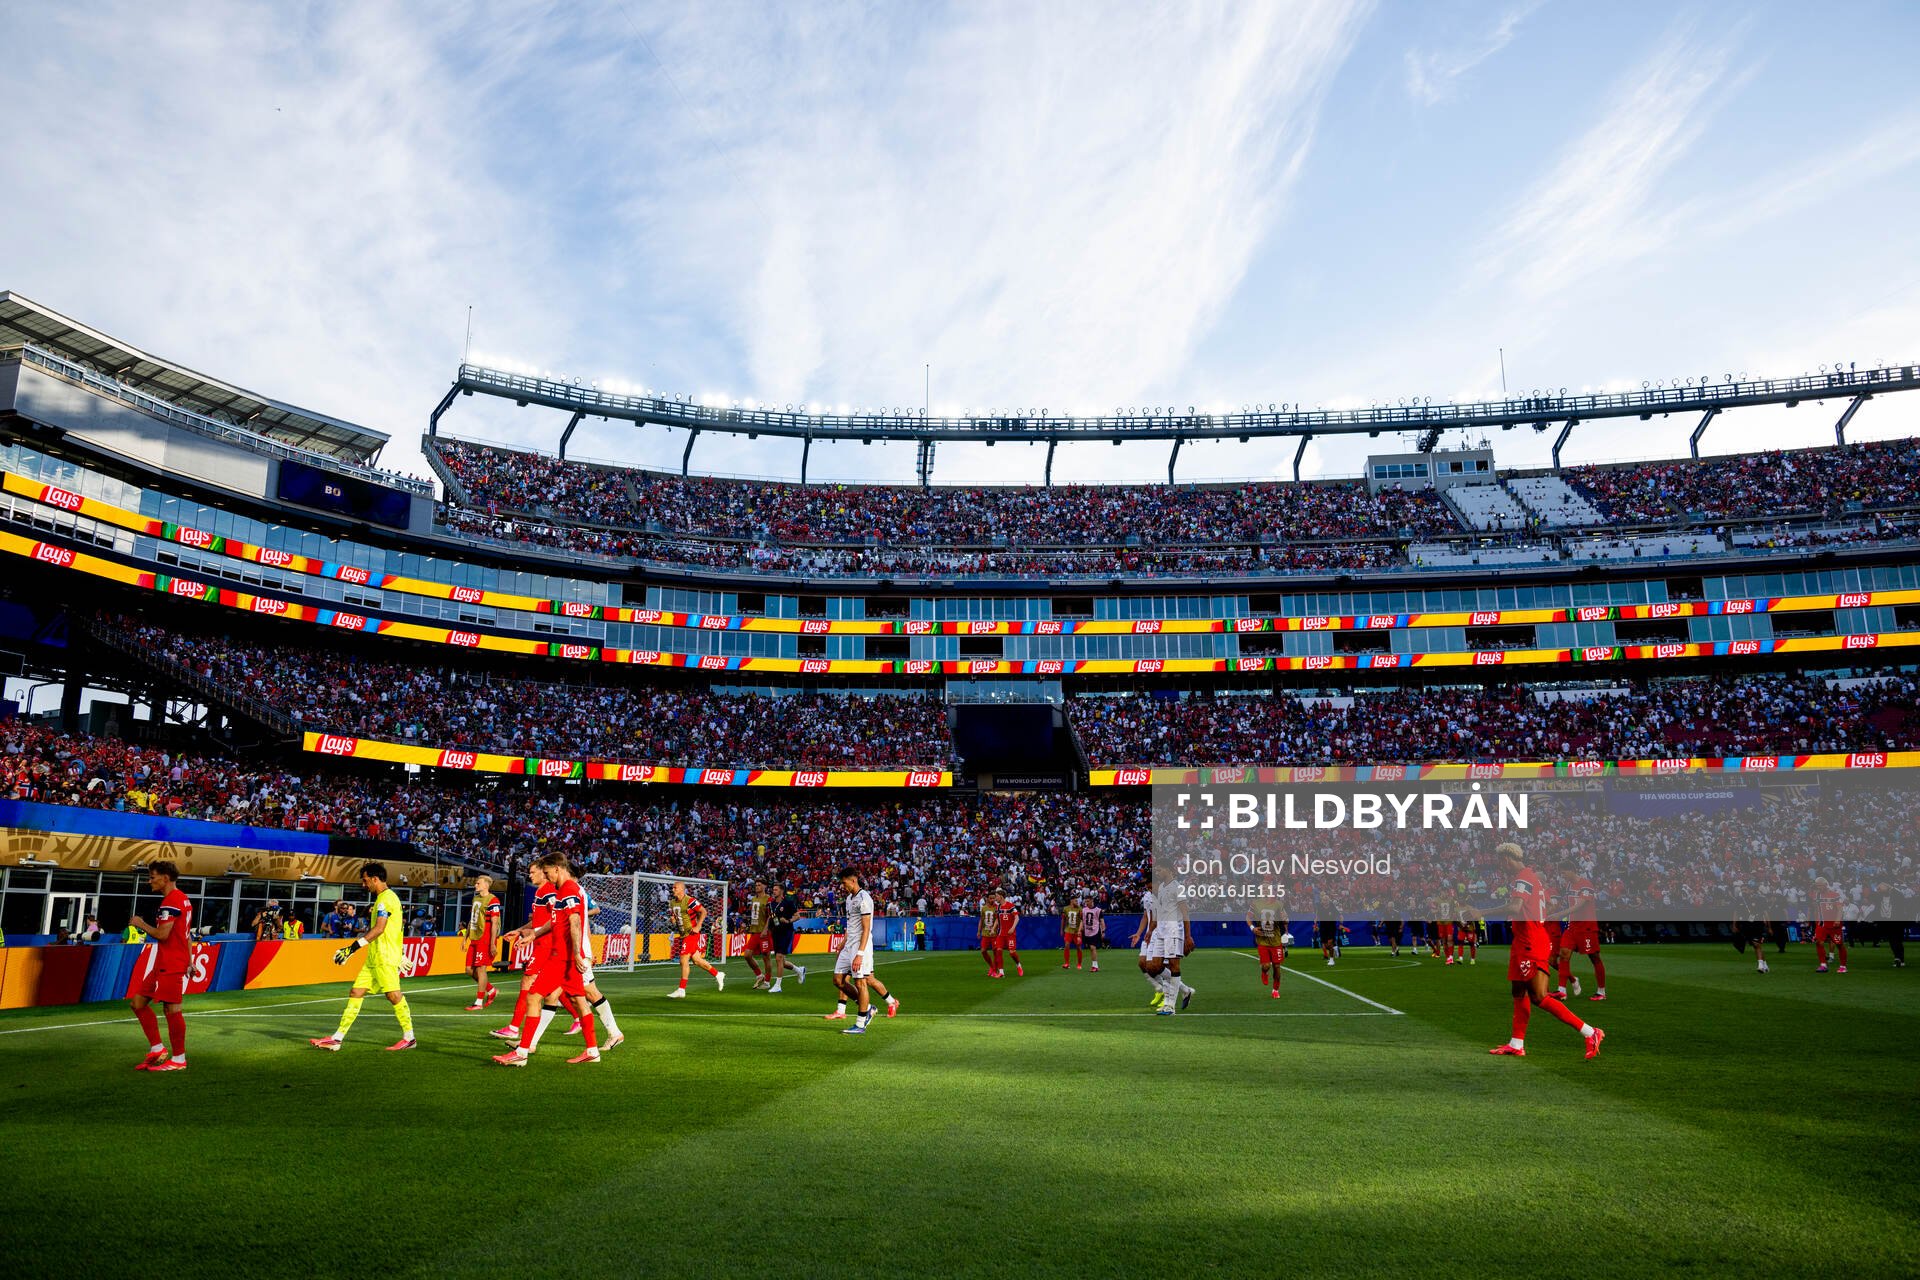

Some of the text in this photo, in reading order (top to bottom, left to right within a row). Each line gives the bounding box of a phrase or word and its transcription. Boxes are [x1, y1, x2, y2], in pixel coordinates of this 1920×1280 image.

[45, 486, 80, 508] Lay's
[36, 543, 71, 564] Lay's
[341, 566, 366, 581] Lay's
[454, 587, 480, 602] Lay's
[1840, 594, 1868, 607] Lay's
[1727, 600, 1751, 613] Lay's
[336, 612, 362, 629] Lay's
[704, 616, 726, 628] Lay's
[1371, 616, 1394, 628] Lay's
[1473, 612, 1497, 624] Lay's
[804, 621, 828, 633] Lay's
[1038, 622, 1060, 633] Lay's
[1136, 620, 1160, 633] Lay's
[450, 630, 477, 646] Lay's
[1847, 634, 1874, 648] Lay's
[1733, 641, 1757, 654] Lay's
[702, 656, 725, 668] Lay's
[1374, 655, 1396, 667] Lay's
[1477, 652, 1502, 664] Lay's
[804, 660, 827, 672] Lay's
[1039, 661, 1061, 672] Lay's
[1138, 660, 1161, 672] Lay's
[321, 734, 352, 755] Lay's
[442, 751, 472, 768] Lay's
[704, 770, 732, 783] Lay's
[795, 772, 824, 786] Lay's
[910, 772, 938, 786] Lay's
[1119, 770, 1146, 784] Lay's
